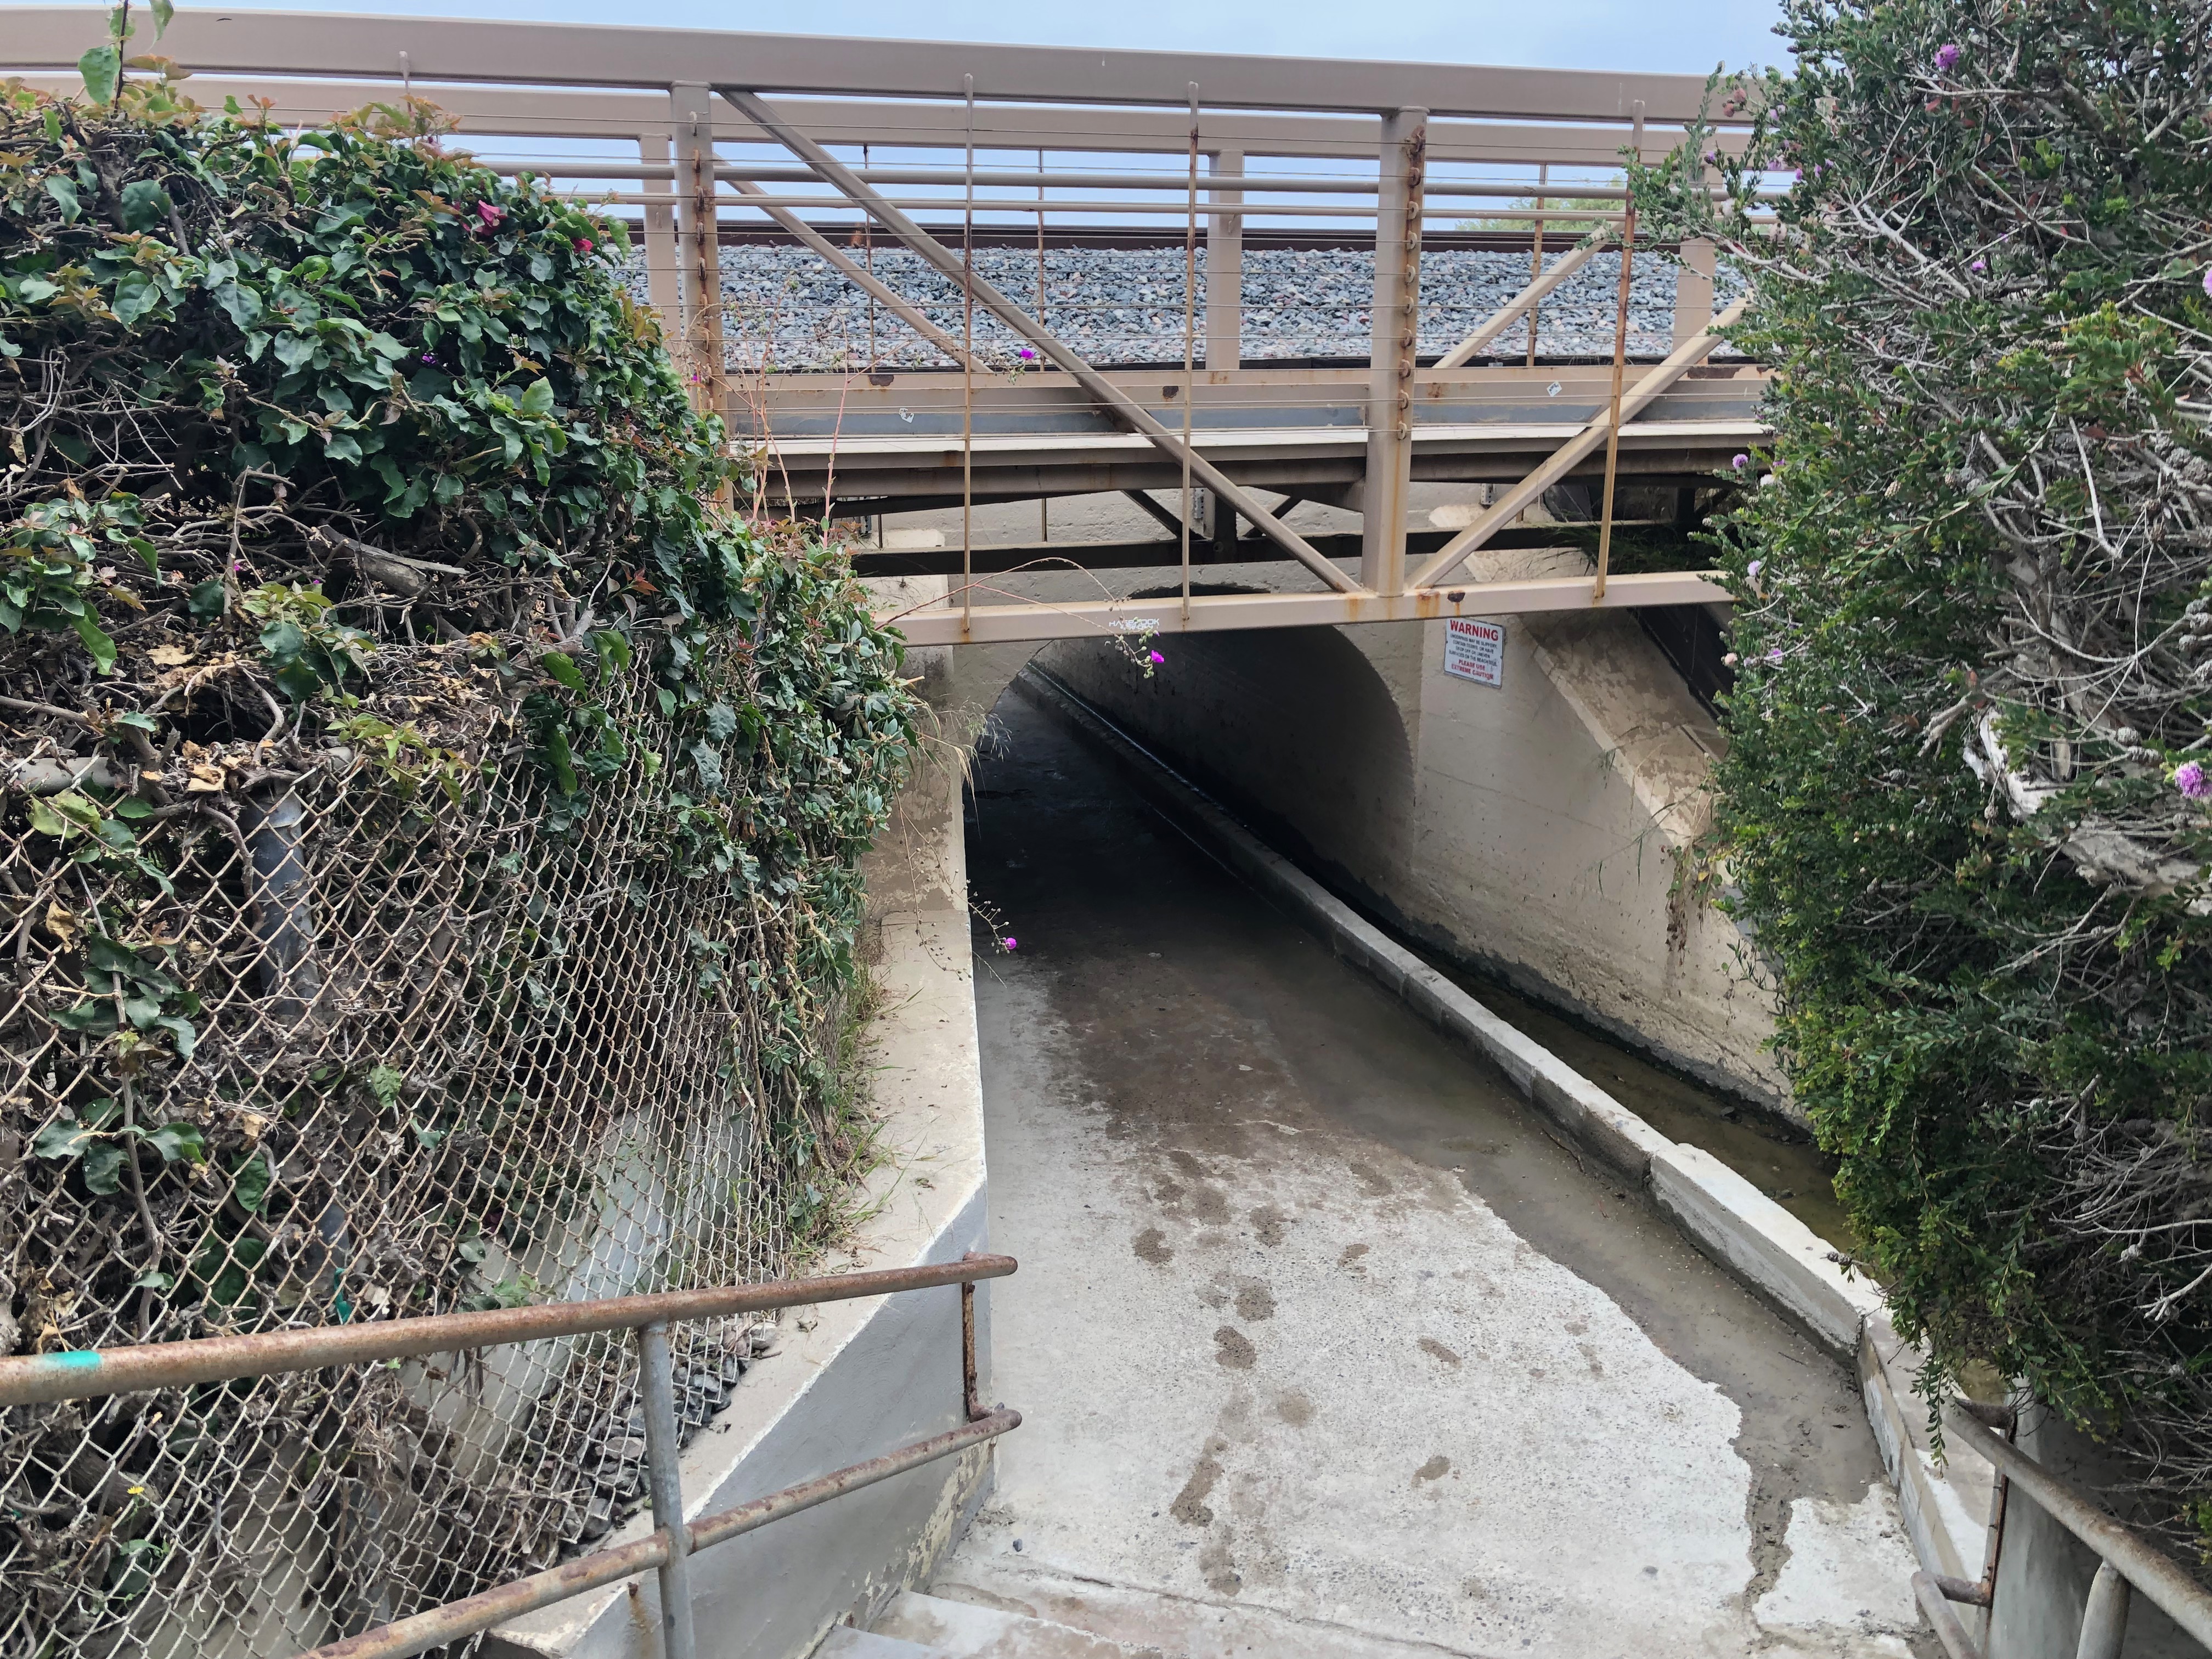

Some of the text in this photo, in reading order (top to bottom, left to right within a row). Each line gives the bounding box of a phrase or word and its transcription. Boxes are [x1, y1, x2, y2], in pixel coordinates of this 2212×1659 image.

[1450, 620, 1498, 641] WARNING
[1459, 659, 1475, 668] PLEASE
[1452, 664, 1493, 680] EXTREME CAUTION
